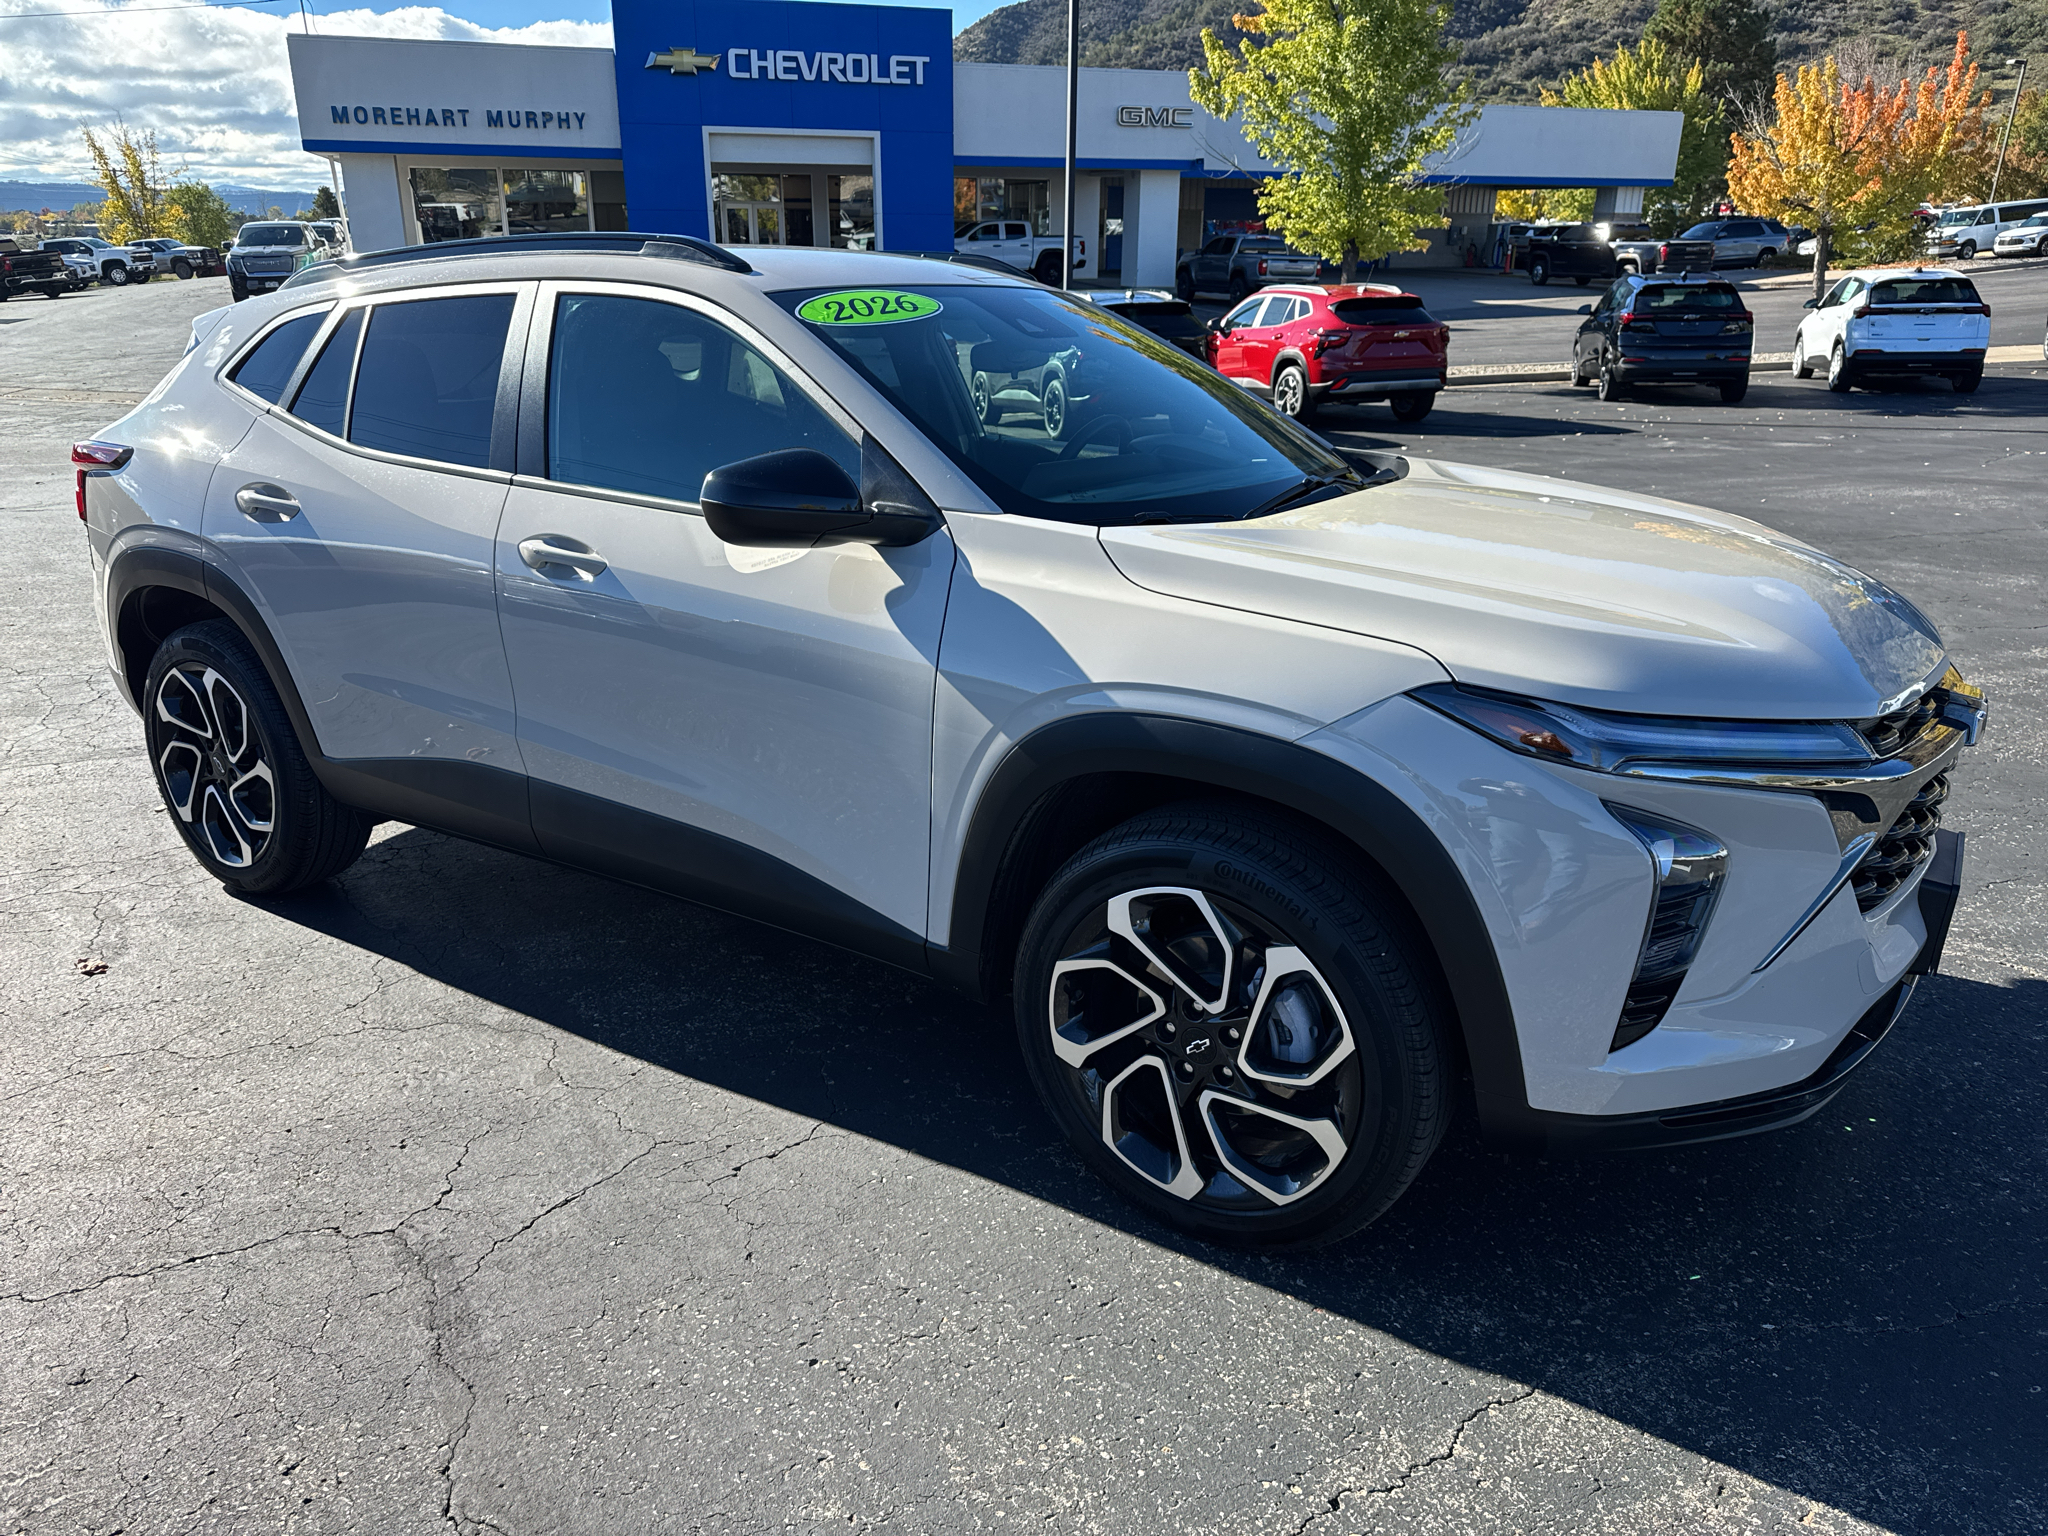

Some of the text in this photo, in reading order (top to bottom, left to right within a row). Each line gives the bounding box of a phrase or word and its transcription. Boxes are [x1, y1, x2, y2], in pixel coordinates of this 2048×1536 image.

[727, 48, 930, 85] CHEVROLET
[331, 105, 586, 130] MOREHART MURPHY
[1118, 106, 1195, 127] GMC
[824, 295, 919, 321] 2026
[1213, 859, 1309, 922] Continental
